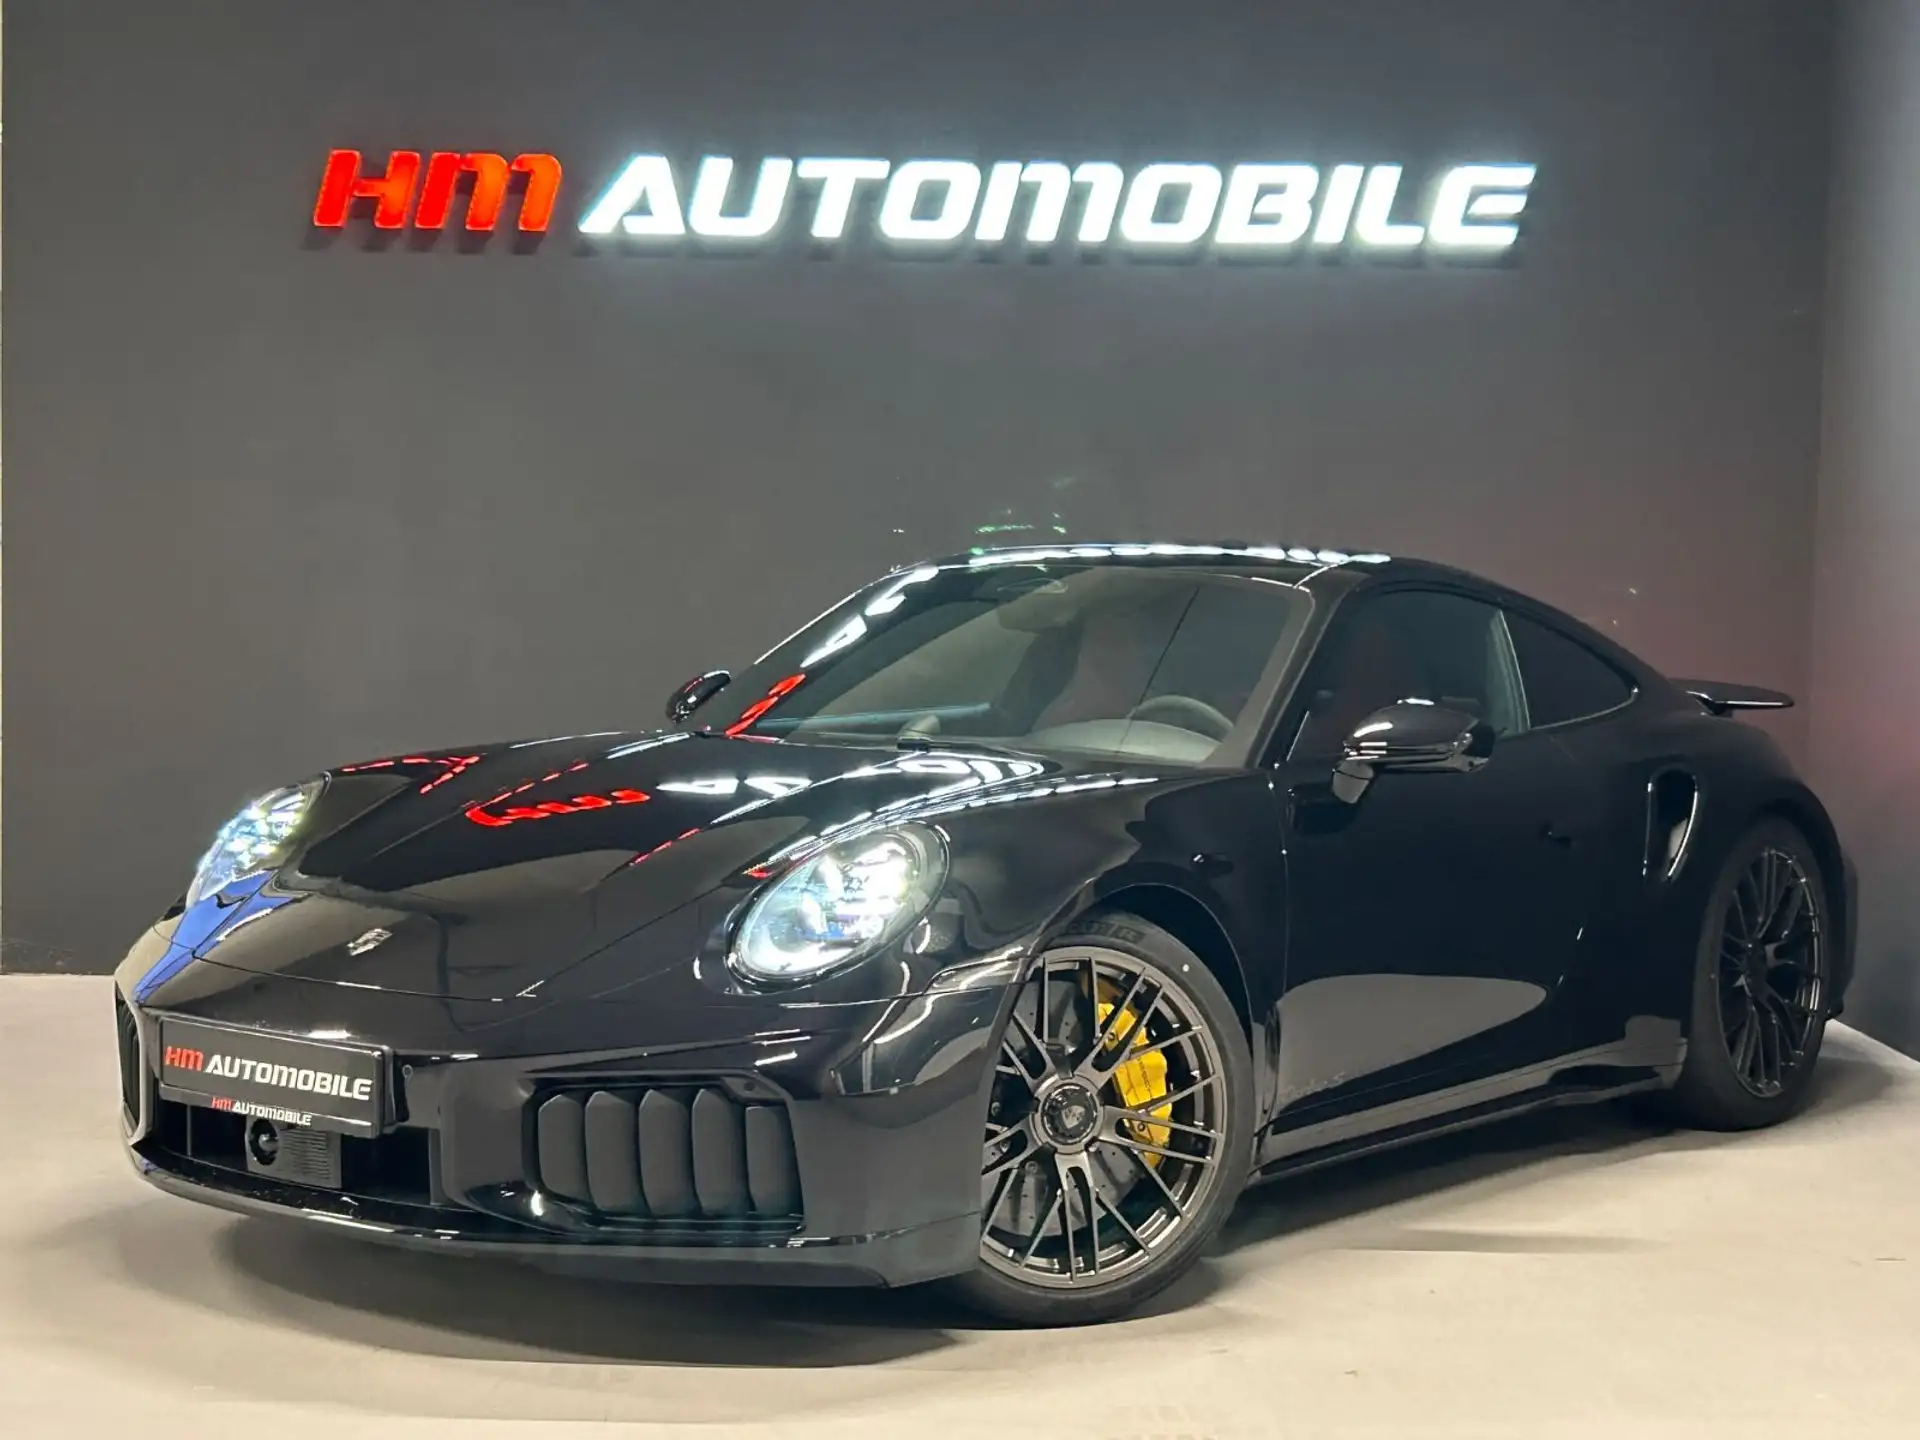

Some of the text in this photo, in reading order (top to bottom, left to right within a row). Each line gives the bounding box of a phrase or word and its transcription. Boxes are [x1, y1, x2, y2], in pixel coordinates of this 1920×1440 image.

[313, 148, 1538, 246] HM AUTOMOBILE
[164, 1046, 374, 1101] HM AUTOMOBILE
[211, 1097, 313, 1127] HM AUTOMOBILE
